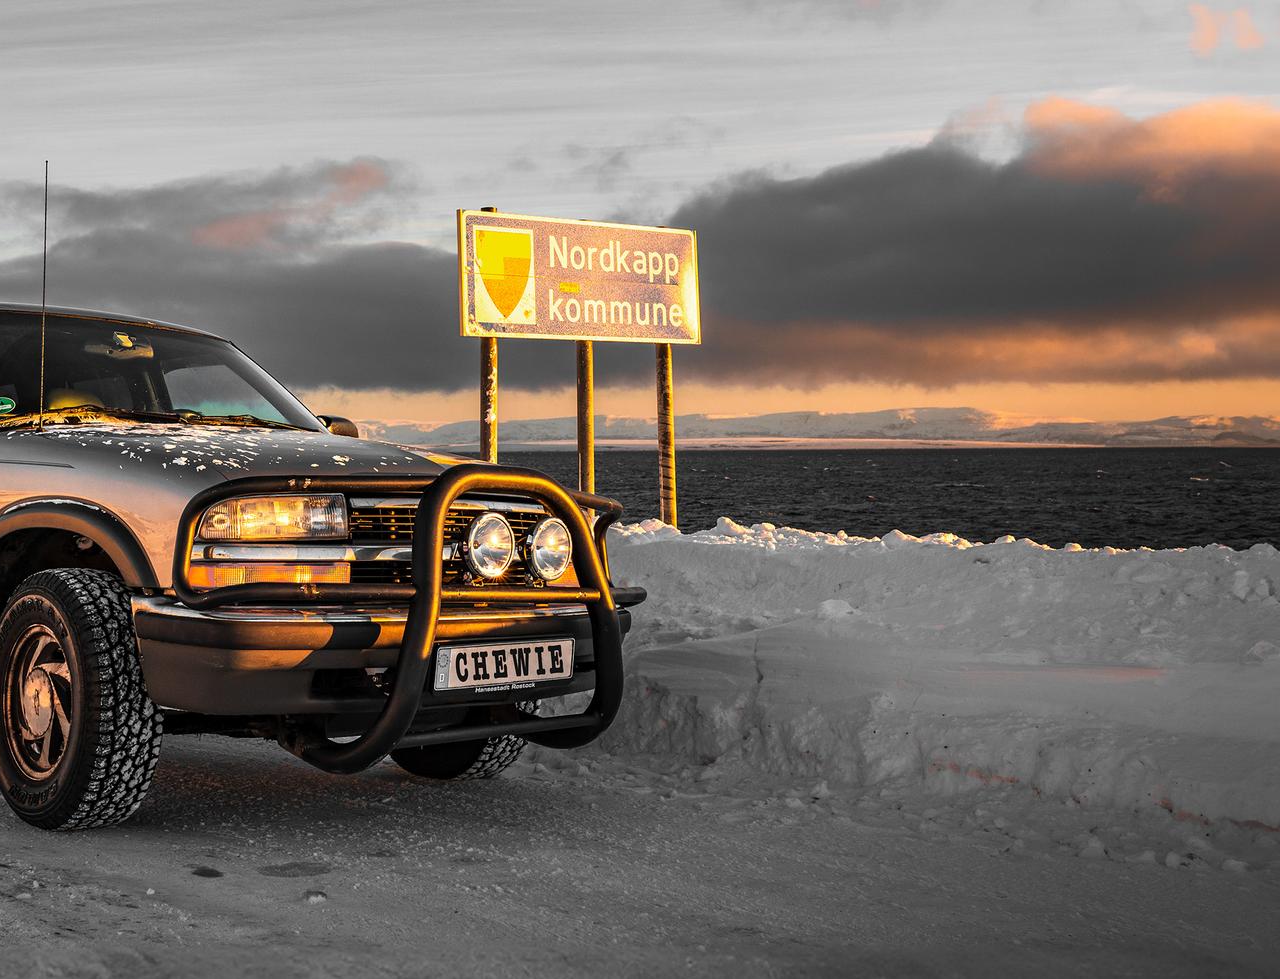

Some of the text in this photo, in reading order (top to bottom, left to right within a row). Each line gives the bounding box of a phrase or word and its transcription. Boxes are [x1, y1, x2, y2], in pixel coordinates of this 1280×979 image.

[549, 236, 679, 284] Nordkapp
[549, 289, 683, 327] kommune
[455, 645, 564, 682] CHEWIE
[475, 685, 510, 693] Hansestadt
